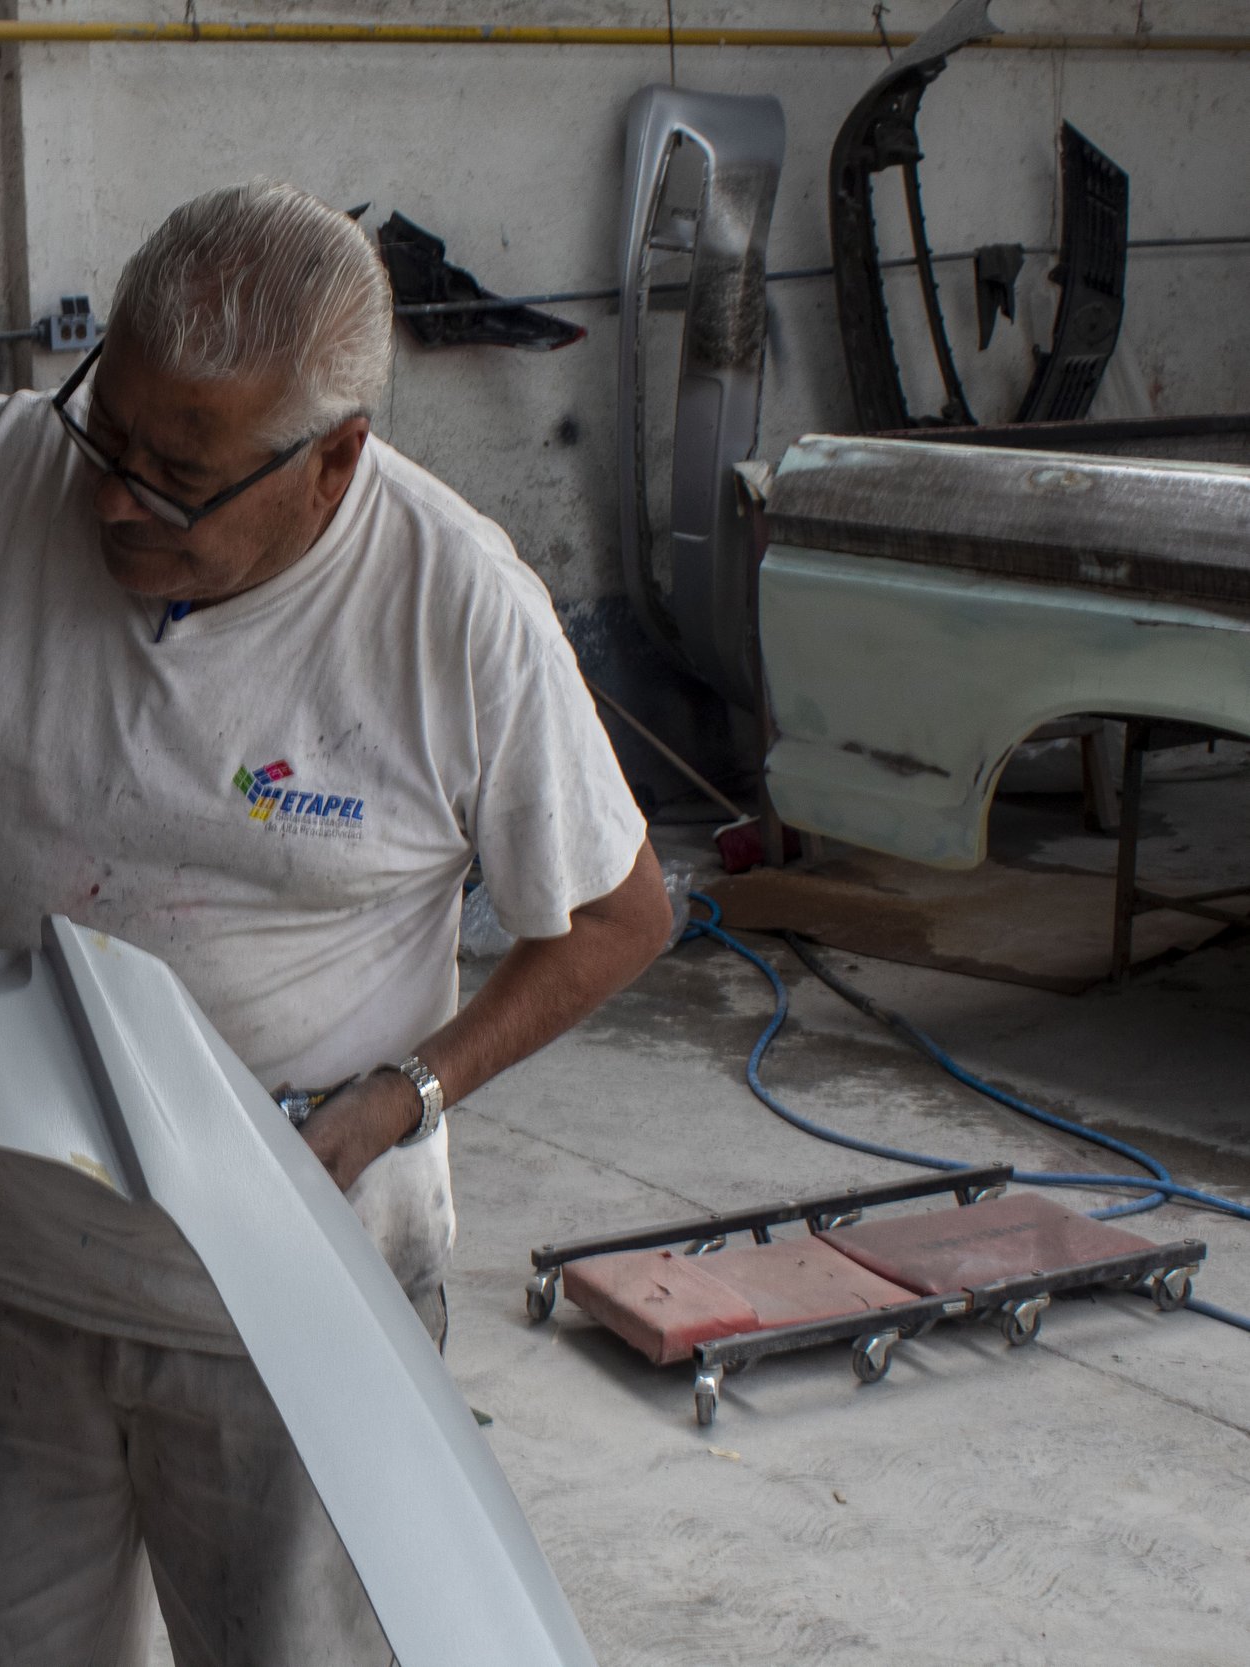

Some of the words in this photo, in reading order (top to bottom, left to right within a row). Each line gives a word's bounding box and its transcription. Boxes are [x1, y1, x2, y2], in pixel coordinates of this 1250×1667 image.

[280, 790, 364, 821] ETAPEL
[264, 822, 277, 832] de
[280, 822, 297, 835] Alta
